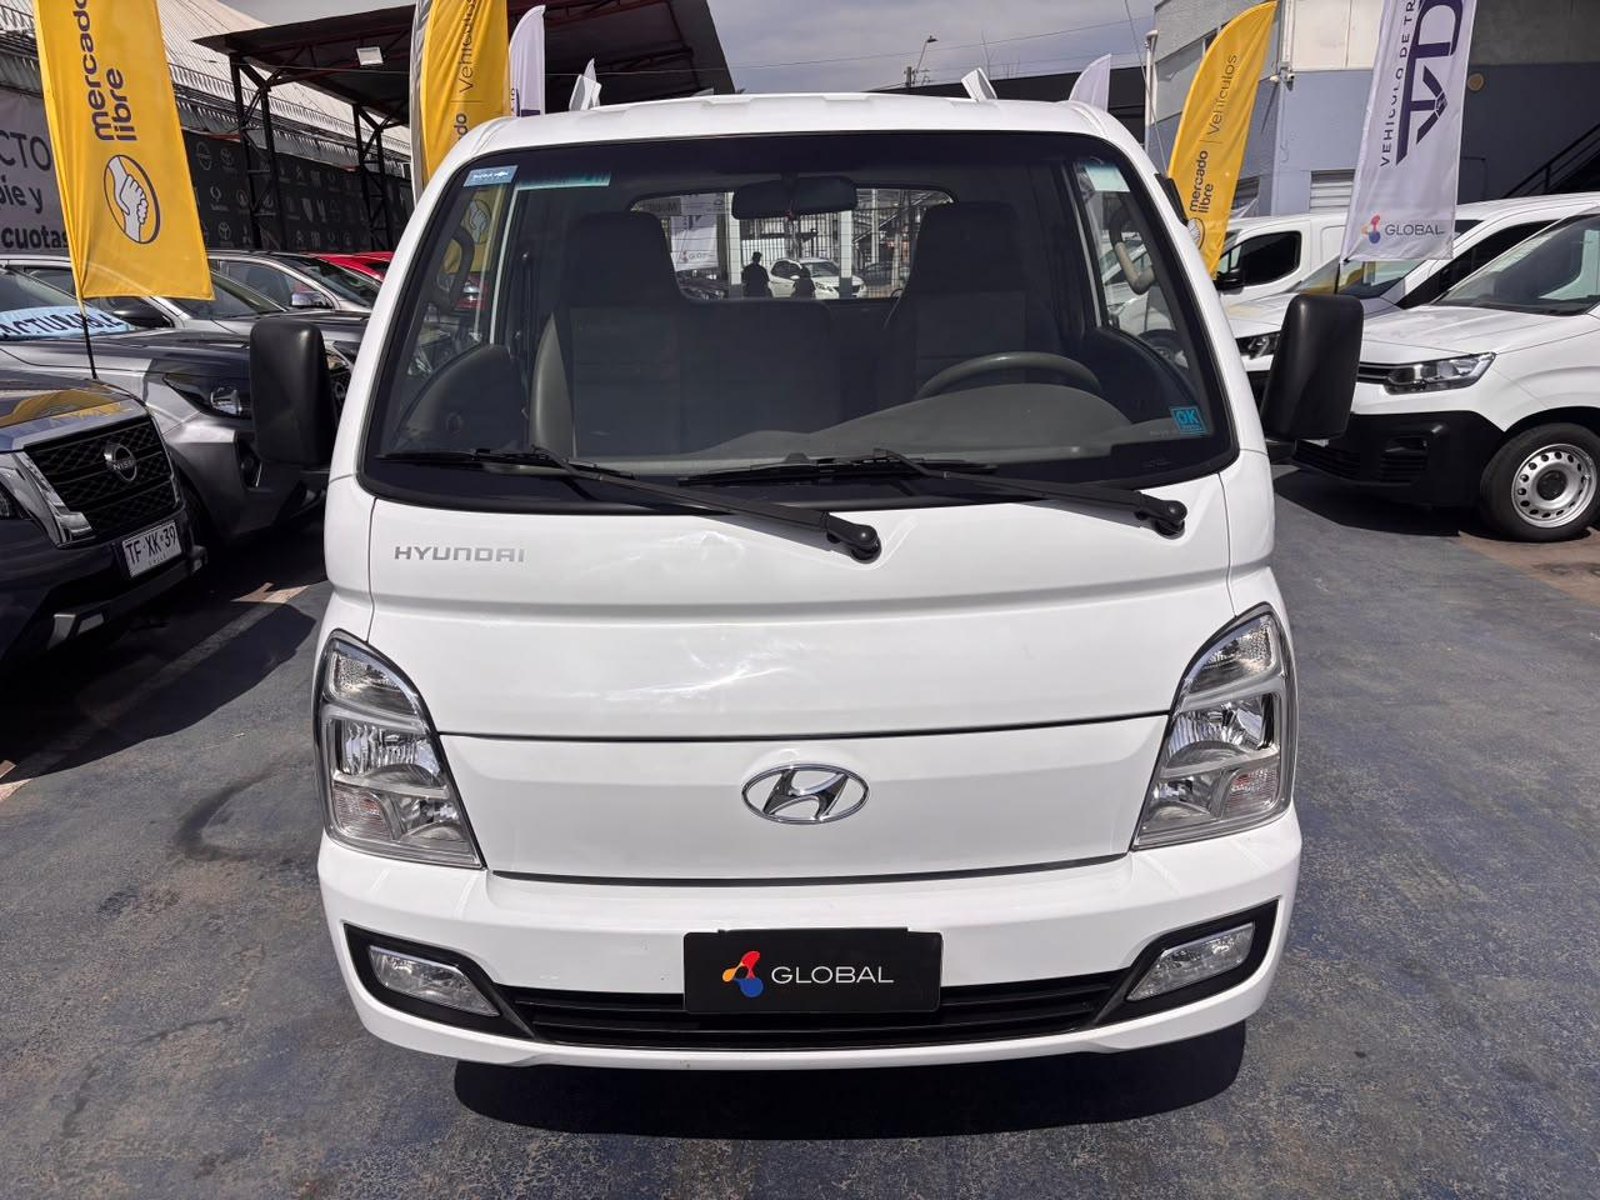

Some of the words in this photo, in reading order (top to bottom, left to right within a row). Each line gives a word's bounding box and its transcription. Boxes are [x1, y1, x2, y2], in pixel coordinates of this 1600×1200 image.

[1399, 33, 1411, 59] DE
[107, 68, 137, 141] libre
[1190, 150, 1209, 212] mercado
[28, 188, 43, 214] y
[1199, 183, 1214, 213] libre
[1384, 223, 1445, 236] GLOBAL
[1175, 409, 1200, 424] OK
[394, 545, 525, 562] HYUNDAI
[771, 966, 895, 984] GLOBAL
